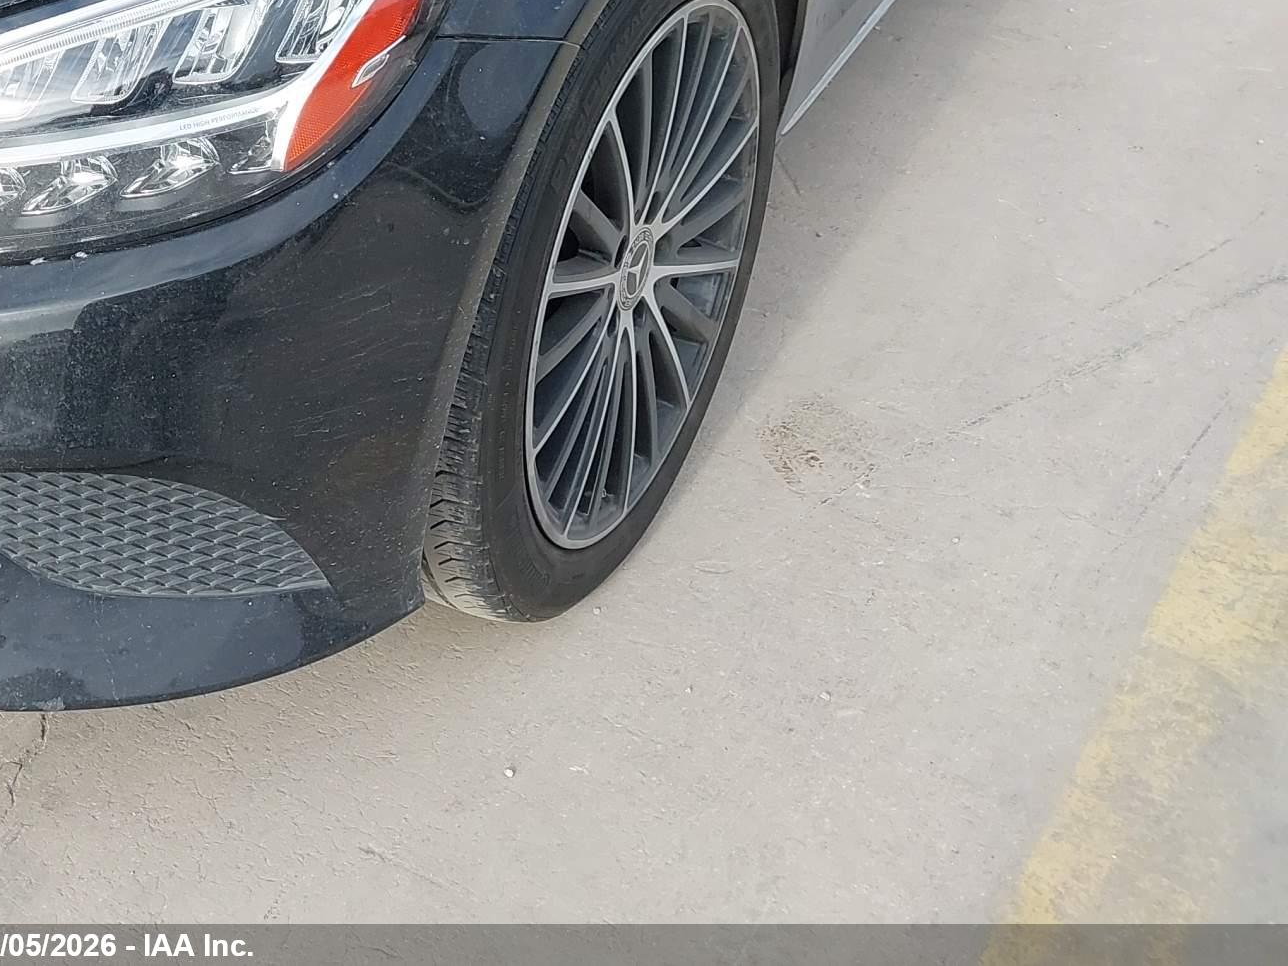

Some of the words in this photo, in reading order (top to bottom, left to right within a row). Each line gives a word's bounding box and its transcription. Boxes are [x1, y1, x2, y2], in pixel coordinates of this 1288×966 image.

[179, 121, 192, 131] LED
[193, 119, 210, 129] HIGH
[211, 106, 259, 124] PERFORMANCE
